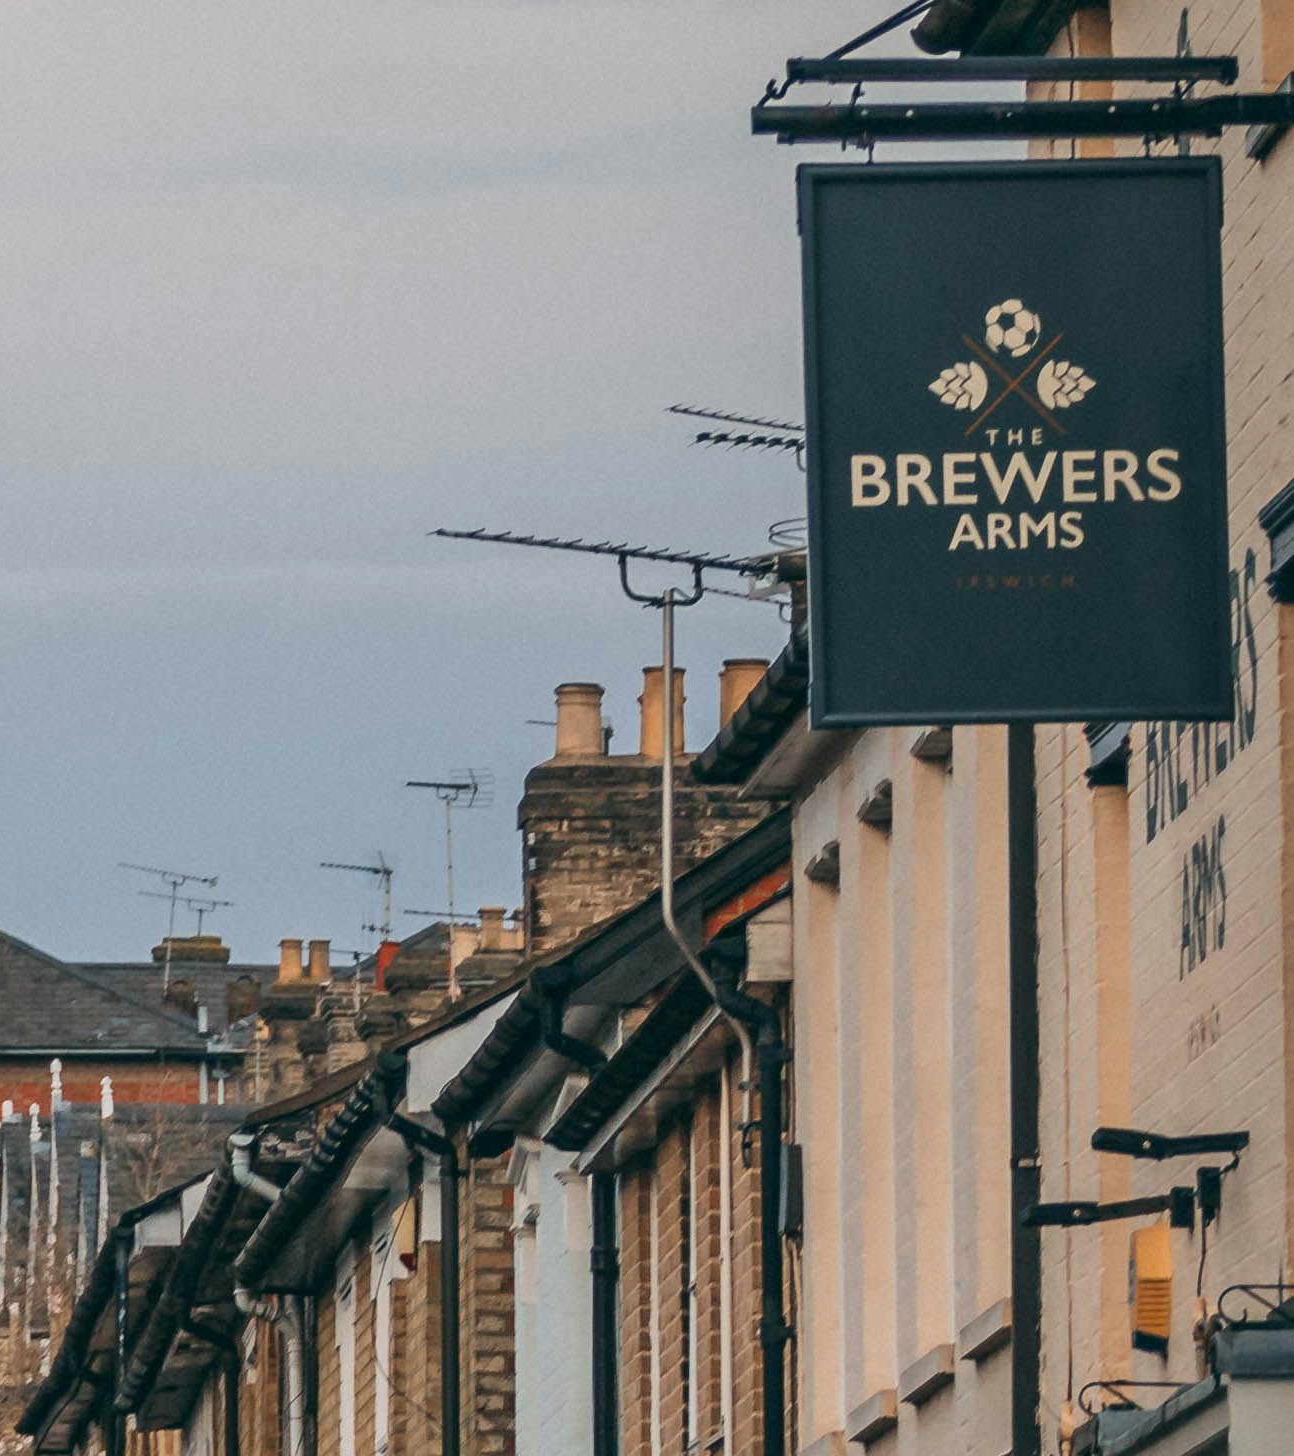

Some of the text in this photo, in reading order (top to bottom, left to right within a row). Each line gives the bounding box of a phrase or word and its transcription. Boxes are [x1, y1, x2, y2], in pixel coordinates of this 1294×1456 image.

[984, 428, 1043, 446] THE
[850, 448, 1182, 508] BREWERS
[948, 510, 1085, 552] ARMS
